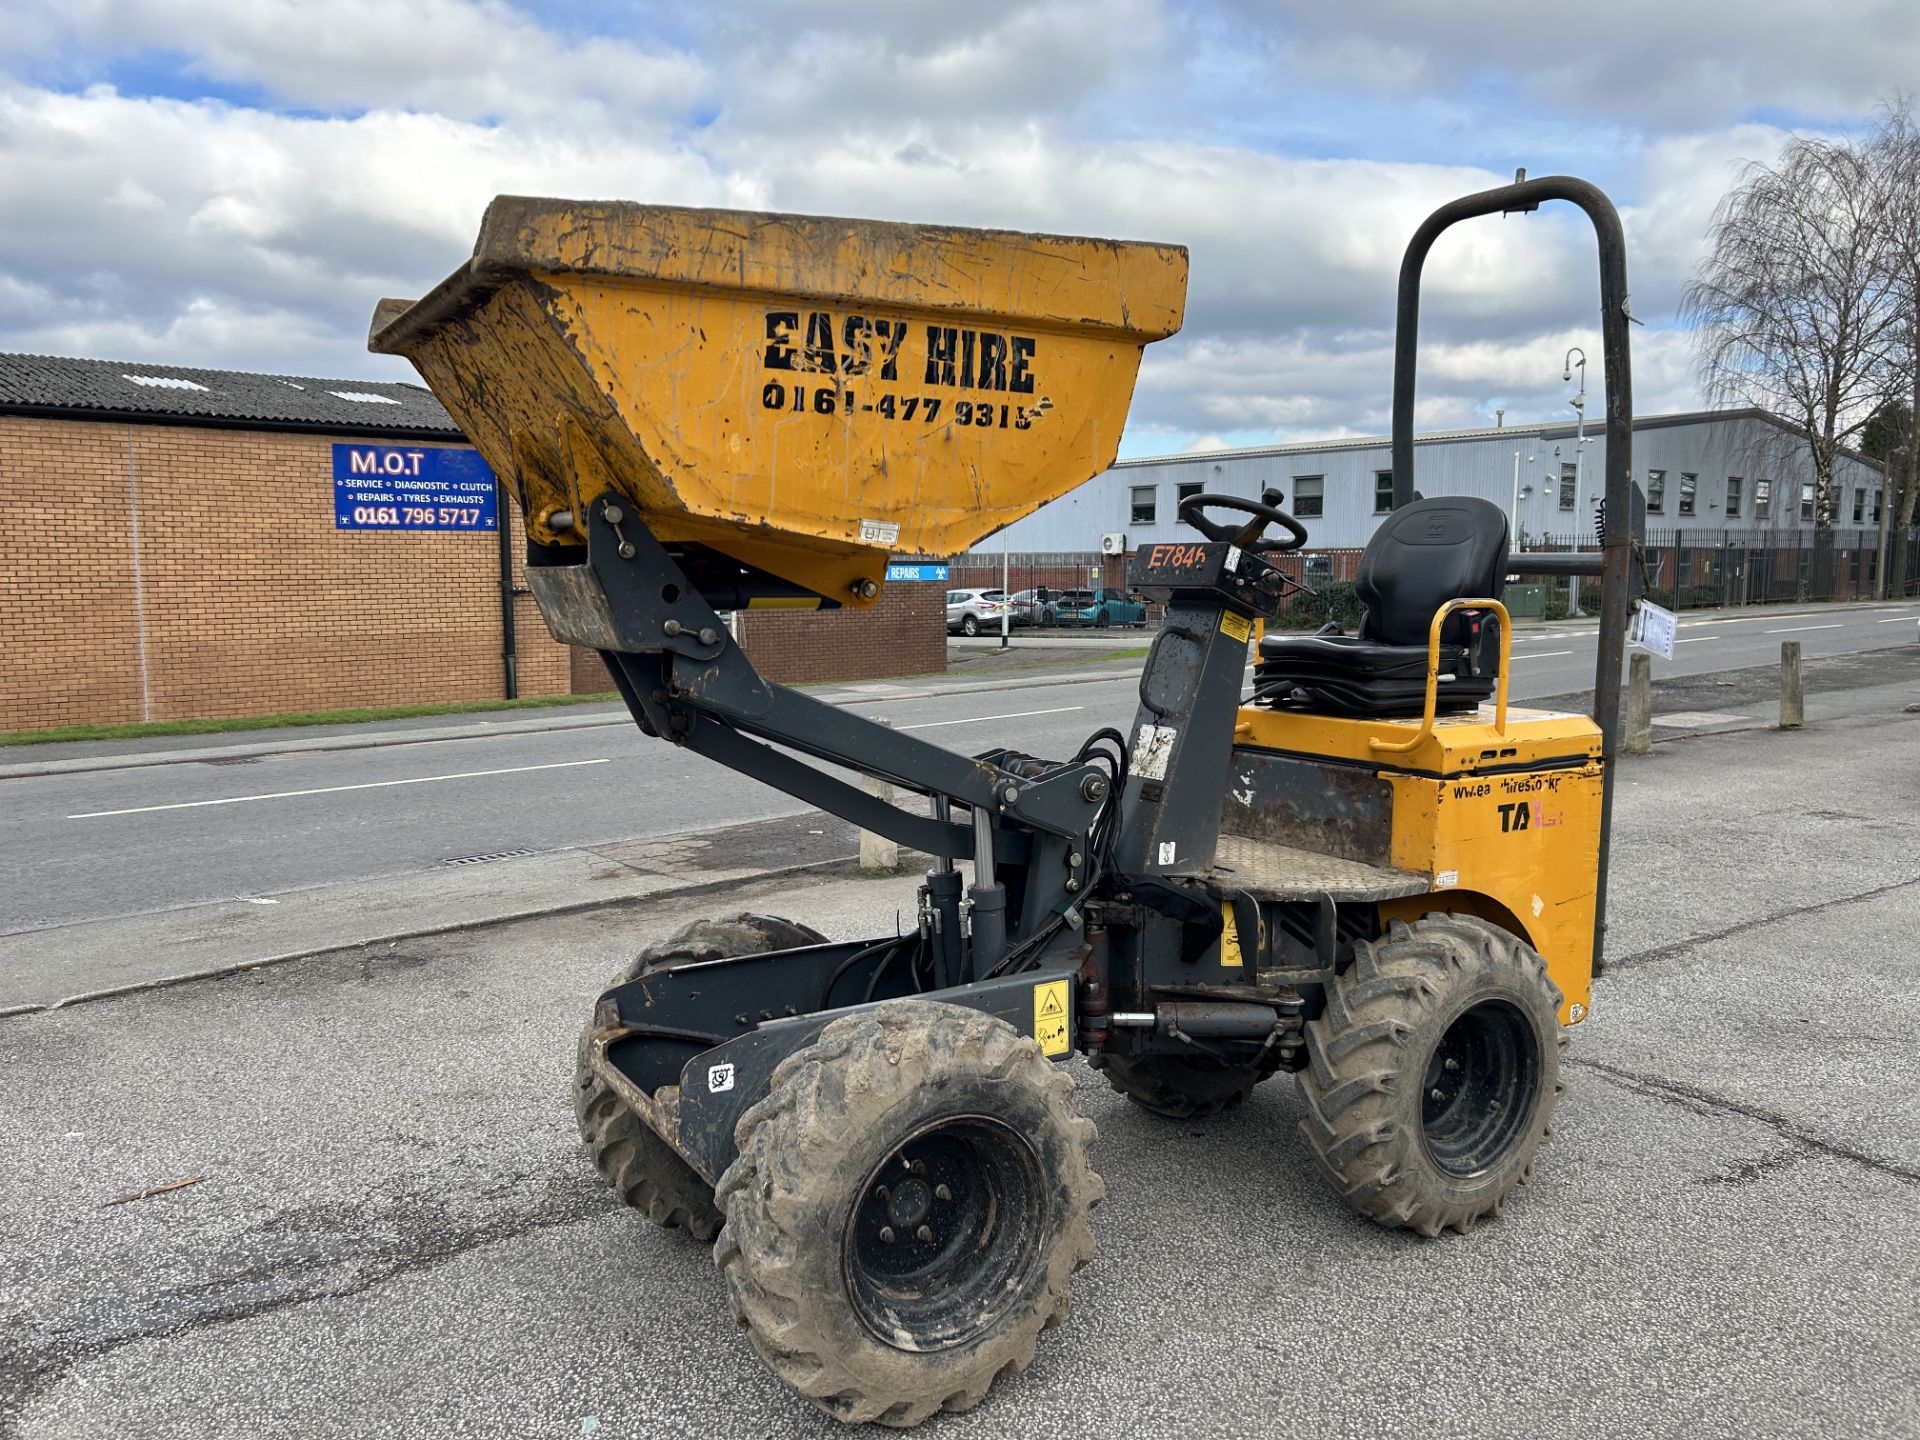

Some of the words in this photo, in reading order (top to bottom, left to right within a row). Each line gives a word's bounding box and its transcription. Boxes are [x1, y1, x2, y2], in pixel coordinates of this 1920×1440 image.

[764, 312, 907, 381] EASY
[924, 326, 1036, 394] HIRE
[762, 383, 942, 423] 0161-477
[351, 450, 424, 475] M.O.T
[345, 480, 383, 489] SERVICE
[394, 481, 450, 490] DIAGNOSTIC
[460, 483, 493, 491] CLUTCH
[357, 493, 394, 502] REPAIRS
[403, 494, 431, 503] TYRES
[439, 495, 484, 504] EXHAUSTS
[354, 507, 400, 524] 0161
[402, 508, 435, 525] 796
[438, 509, 480, 525] 5717
[891, 567, 920, 579] REPAIRS
